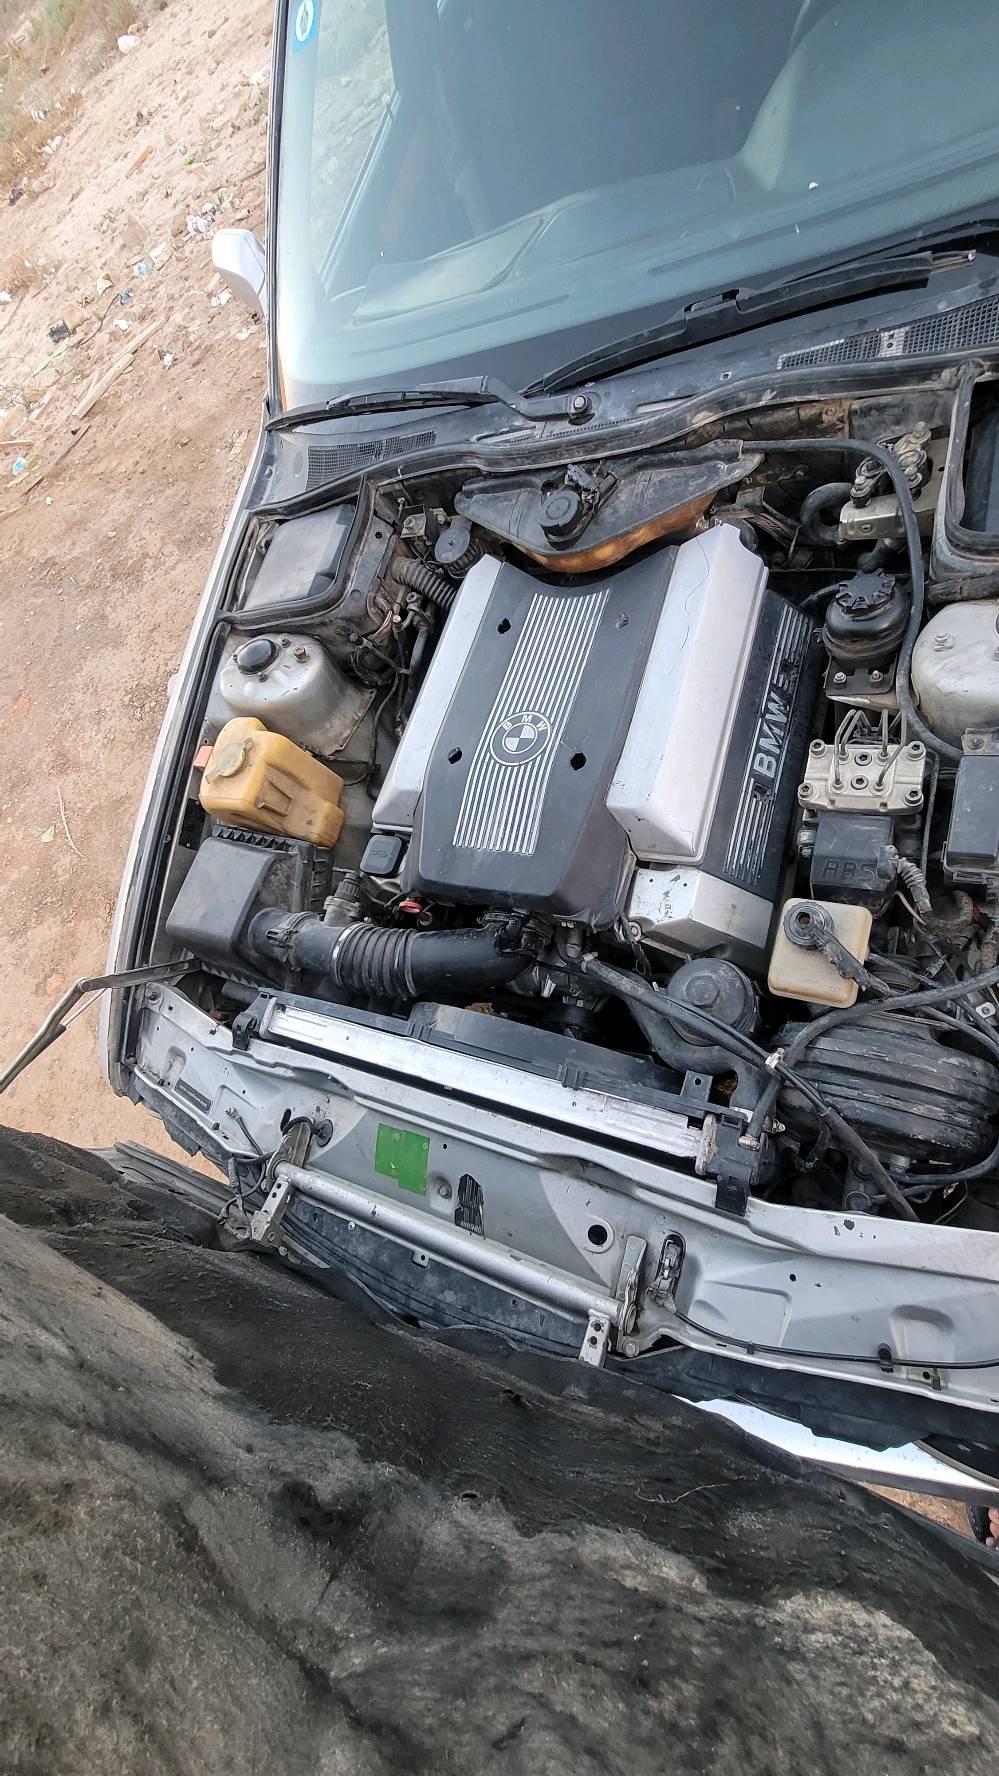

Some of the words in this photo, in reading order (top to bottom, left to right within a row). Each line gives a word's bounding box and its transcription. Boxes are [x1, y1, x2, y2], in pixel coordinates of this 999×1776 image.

[502, 714, 547, 732] BMW
[753, 691, 788, 779] BMW
[822, 858, 877, 882] ABS
